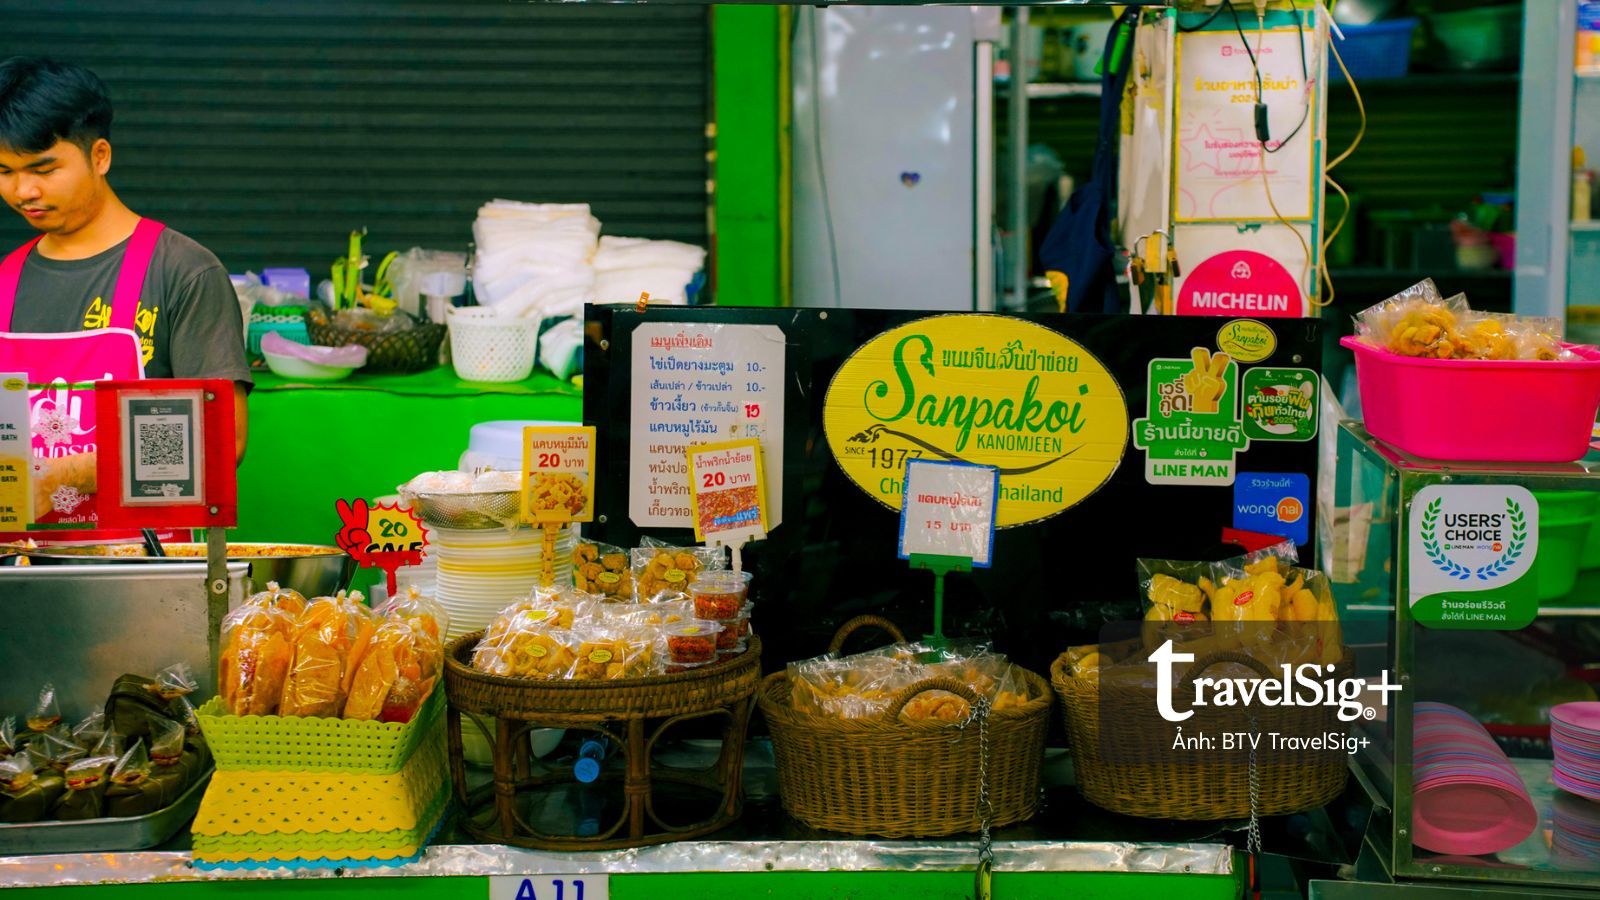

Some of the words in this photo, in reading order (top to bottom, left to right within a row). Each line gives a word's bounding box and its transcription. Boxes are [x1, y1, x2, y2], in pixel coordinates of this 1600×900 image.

[1191, 291, 1288, 311] MICHELIN
[864, 334, 1088, 452] Sanpakoi
[649, 420, 718, 437] แคบหมูไร้มัน
[1144, 418, 1240, 443] ร้านนี้ขายดี
[532, 436, 589, 453] แคบหมูมีมัน
[845, 446, 865, 455] SINCE
[976, 434, 1062, 453] KANOMJEEN
[538, 453, 561, 468] 20
[564, 458, 584, 467] บาท
[1153, 464, 1187, 477] LINE
[1190, 464, 1228, 477] MAN
[703, 472, 725, 488] 20
[730, 473, 751, 485] บาท
[999, 483, 1063, 503] hailand
[1237, 501, 1299, 518] wongnai
[378, 518, 408, 537] 20
[926, 520, 942, 530] 15
[1444, 513, 1506, 528] USERS'
[1445, 529, 1502, 541] CHOICE
